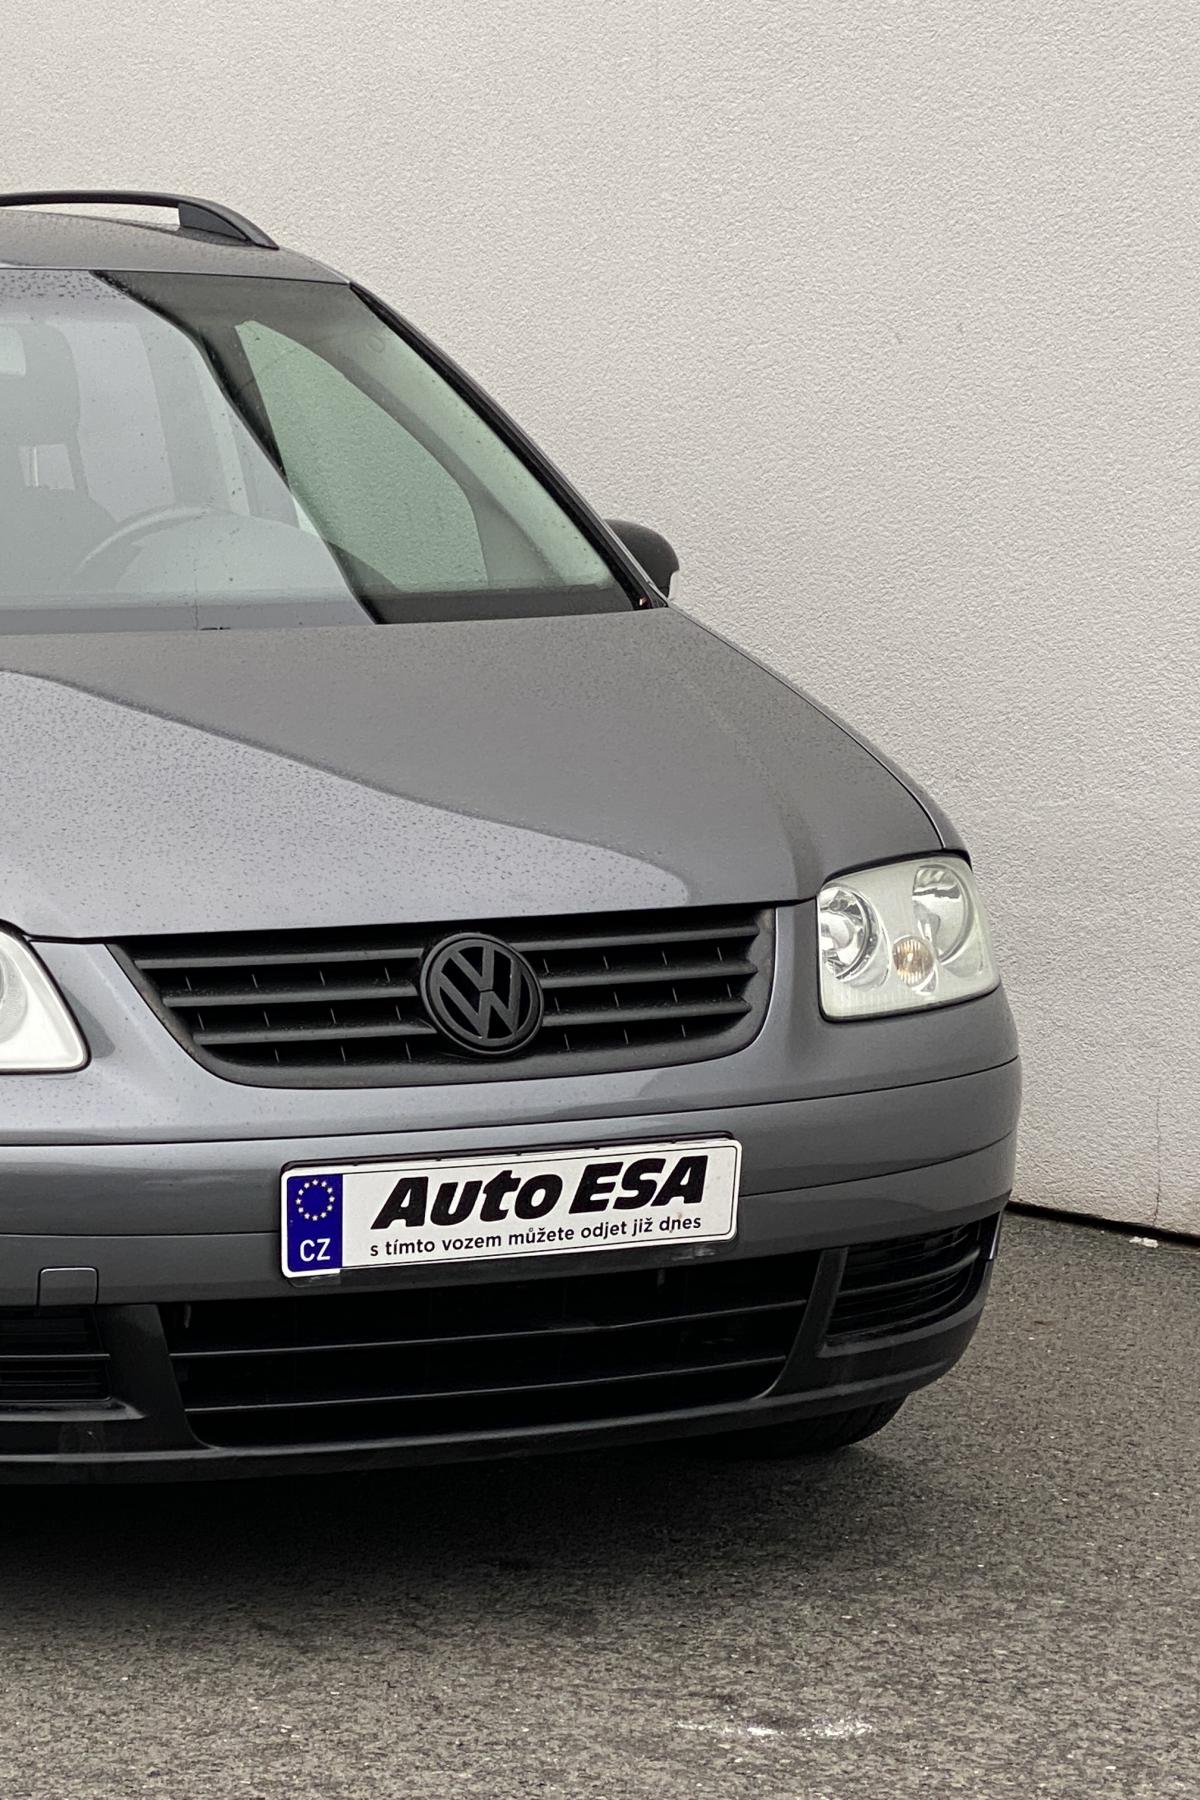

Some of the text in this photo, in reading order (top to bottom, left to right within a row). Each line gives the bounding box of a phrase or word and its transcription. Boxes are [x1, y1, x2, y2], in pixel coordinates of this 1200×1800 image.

[432, 942, 530, 1044] VW
[370, 1154, 709, 1230] Auto ESA
[299, 1237, 331, 1262] CZ
[370, 1216, 701, 1257] s tímto vozem můžete odjet již dnes
